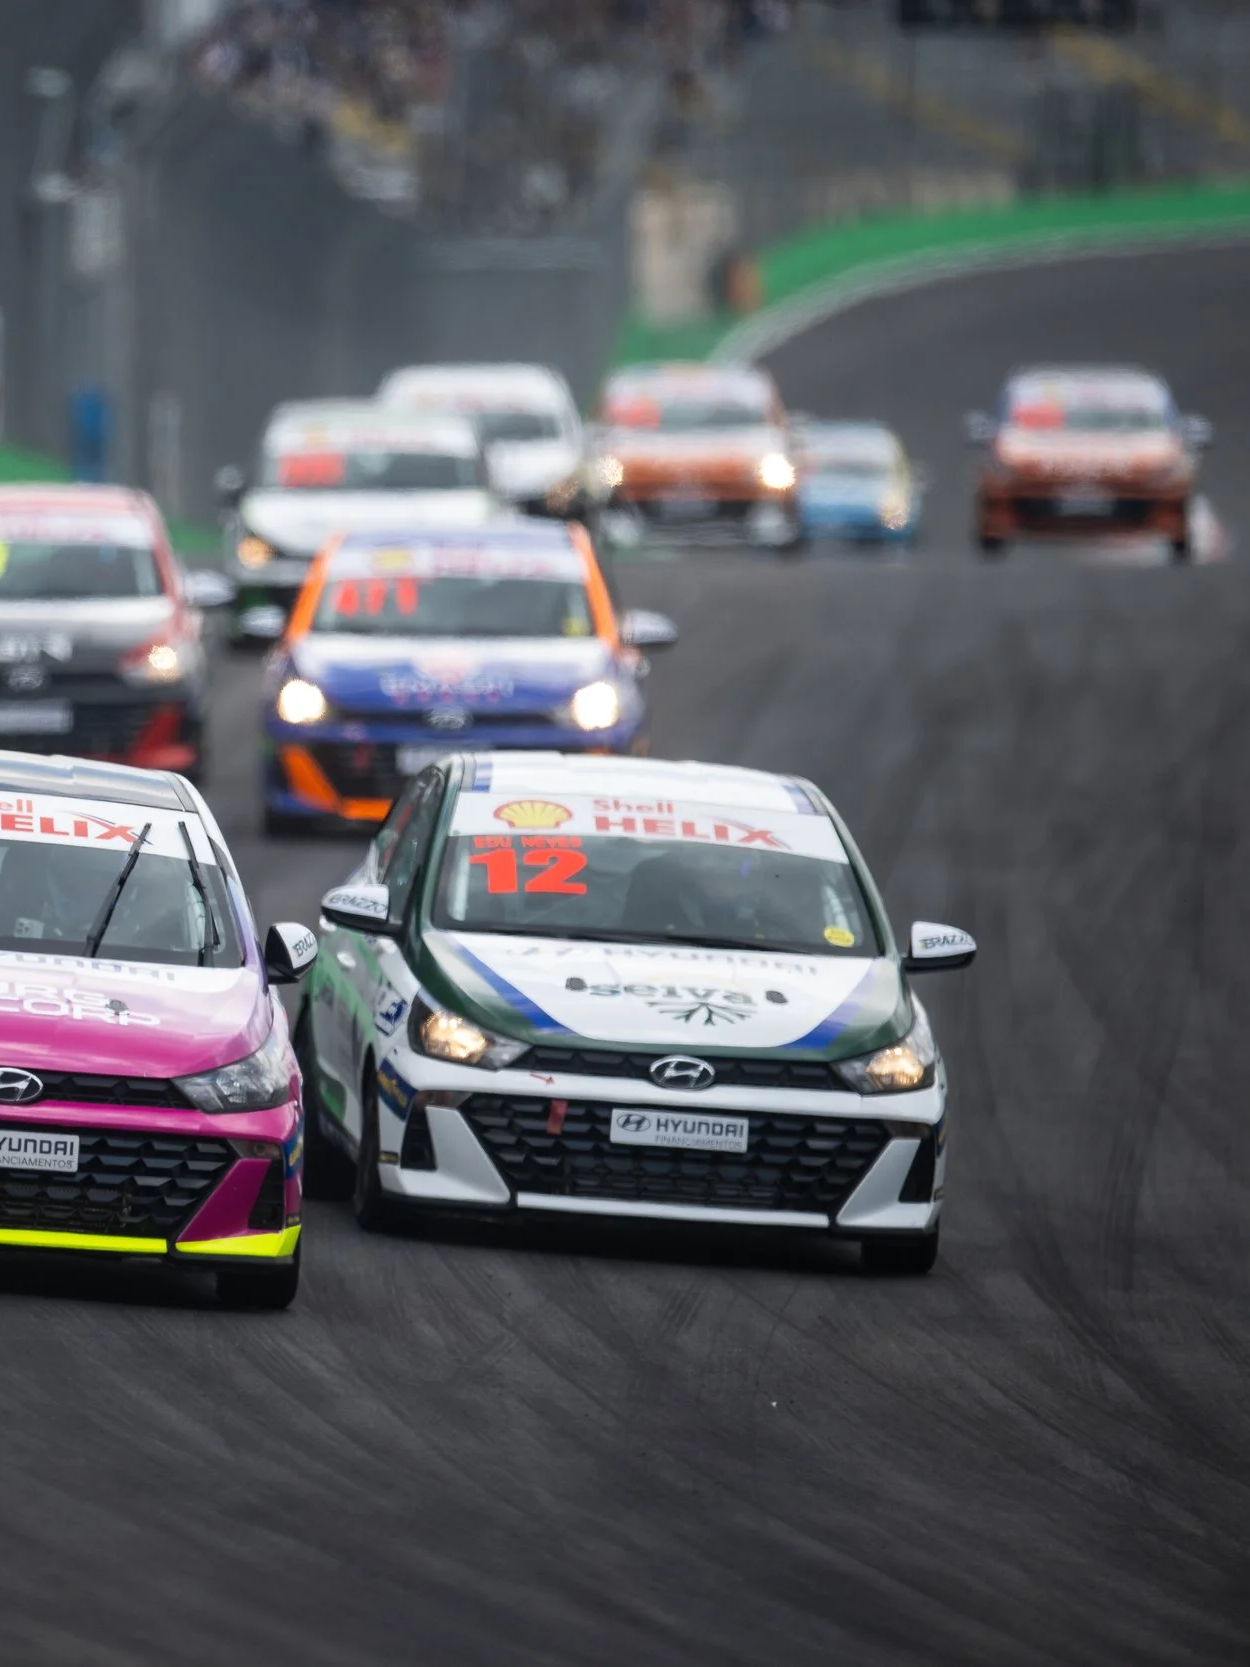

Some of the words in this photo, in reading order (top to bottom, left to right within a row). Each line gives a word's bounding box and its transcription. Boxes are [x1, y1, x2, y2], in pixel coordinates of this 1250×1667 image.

[593, 798, 674, 814] Shell
[595, 815, 786, 849] HELIX
[468, 848, 587, 895] 12
[656, 1118, 743, 1138] HYUNDAI
